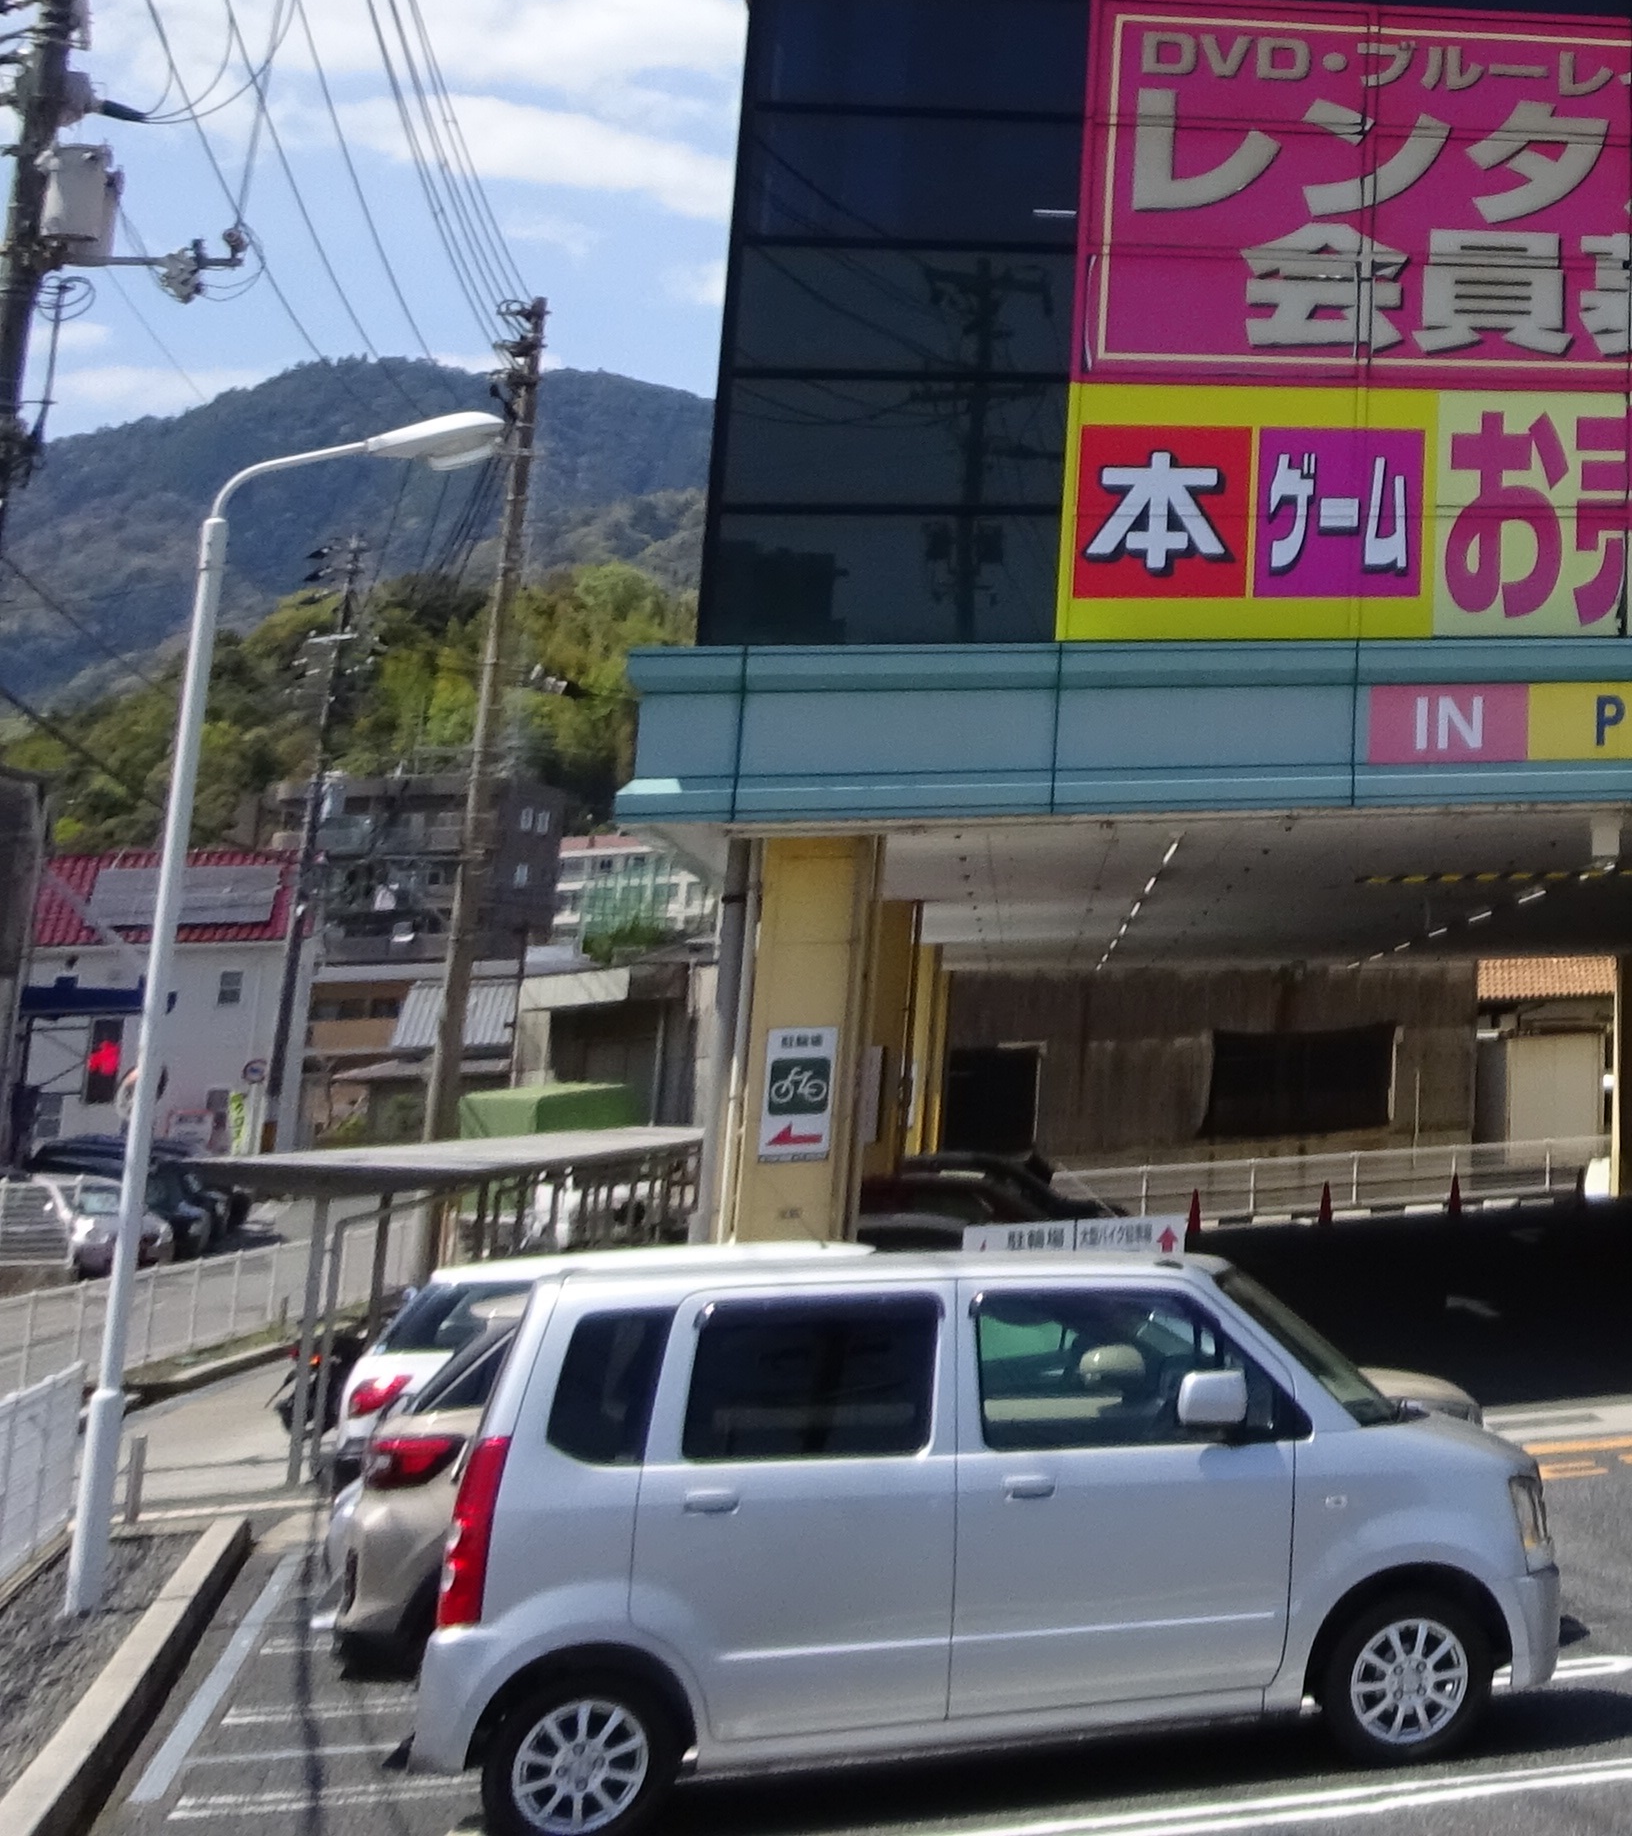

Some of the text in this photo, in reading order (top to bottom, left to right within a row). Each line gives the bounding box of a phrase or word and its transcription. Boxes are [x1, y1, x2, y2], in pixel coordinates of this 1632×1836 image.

[1086, 450, 1226, 569] 本
[1269, 452, 1407, 568] ゲーム
[1413, 694, 1484, 751] IN
[1595, 695, 1625, 747] P
